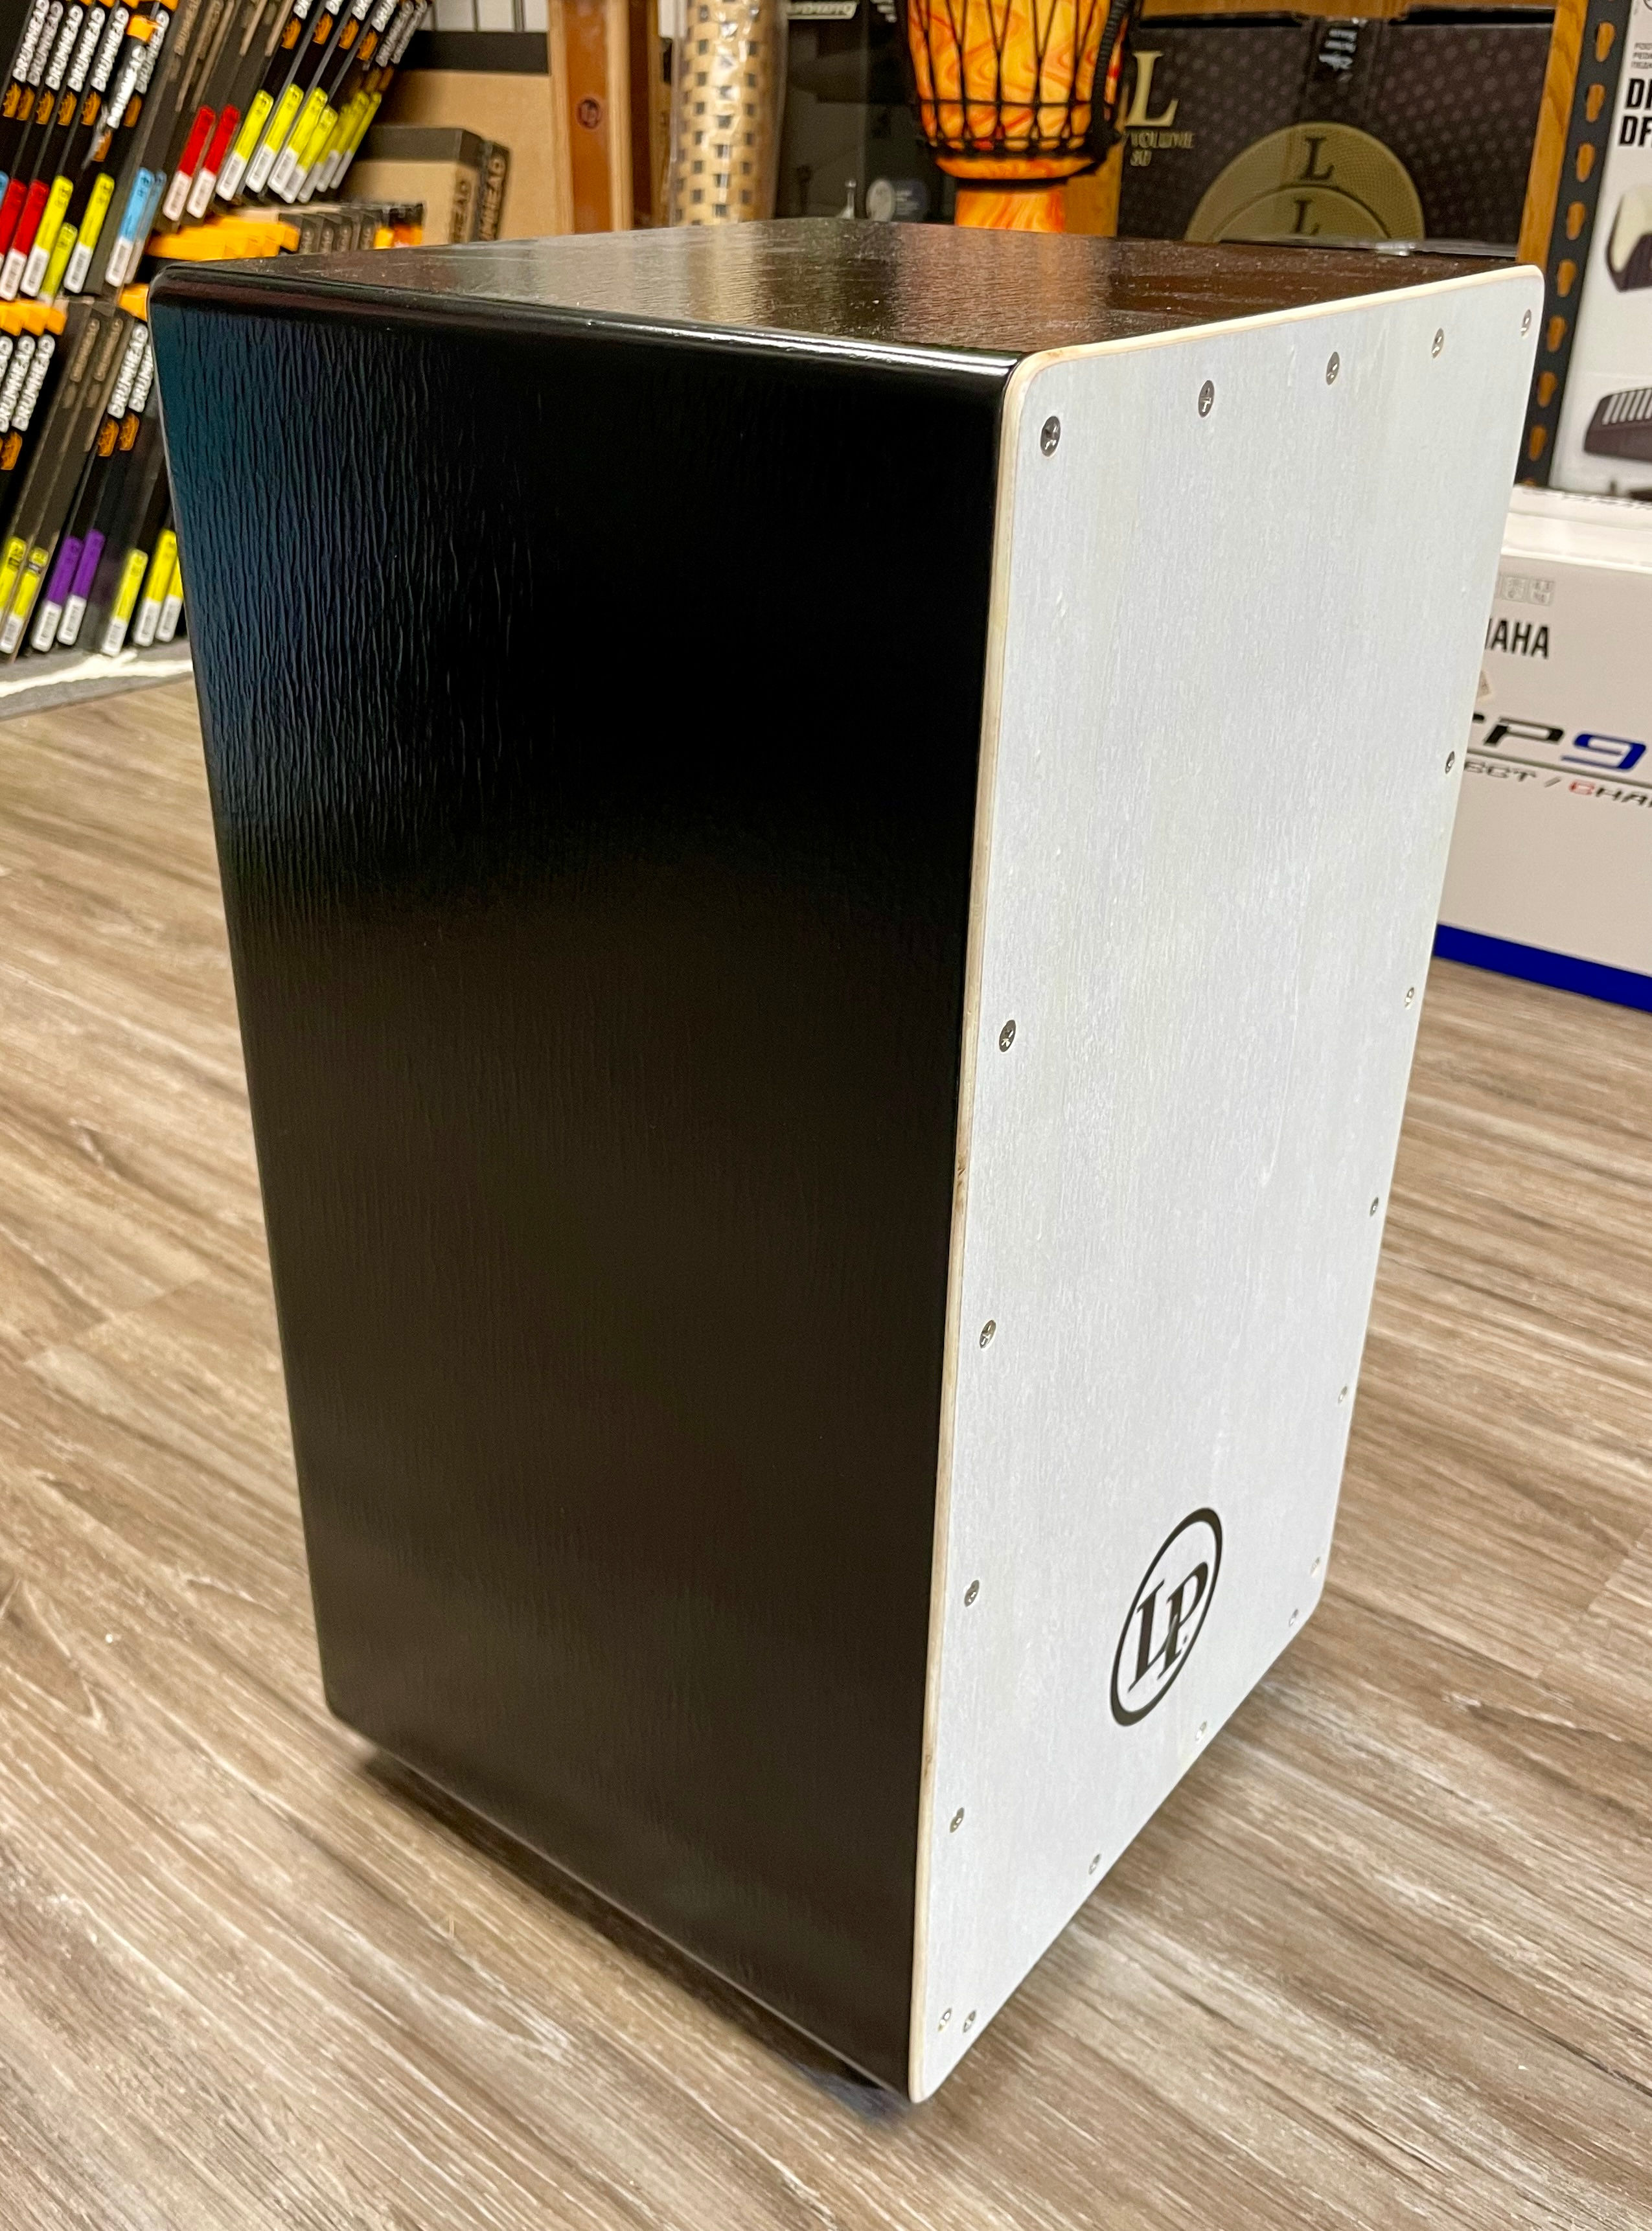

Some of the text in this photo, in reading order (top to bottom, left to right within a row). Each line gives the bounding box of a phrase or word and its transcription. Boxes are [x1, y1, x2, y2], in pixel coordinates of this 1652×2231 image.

[12, 0, 50, 84] DRUMHEAD
[27, 1, 63, 87] DRUMHEAD
[45, 5, 84, 91] DRUMHEAD
[67, 7, 106, 92] DRUMHEAD
[91, 7, 130, 92] DRUMHEAD
[107, 45, 146, 129] DRUMHEAD
[1125, 51, 1179, 127] L
[1300, 137, 1335, 181] L
[12, 334, 56, 432] DRUMHEAD
[108, 325, 148, 419] DRUMHEAD
[1472, 711, 1647, 770] P9
[1128, 1561, 1210, 1693] LP
